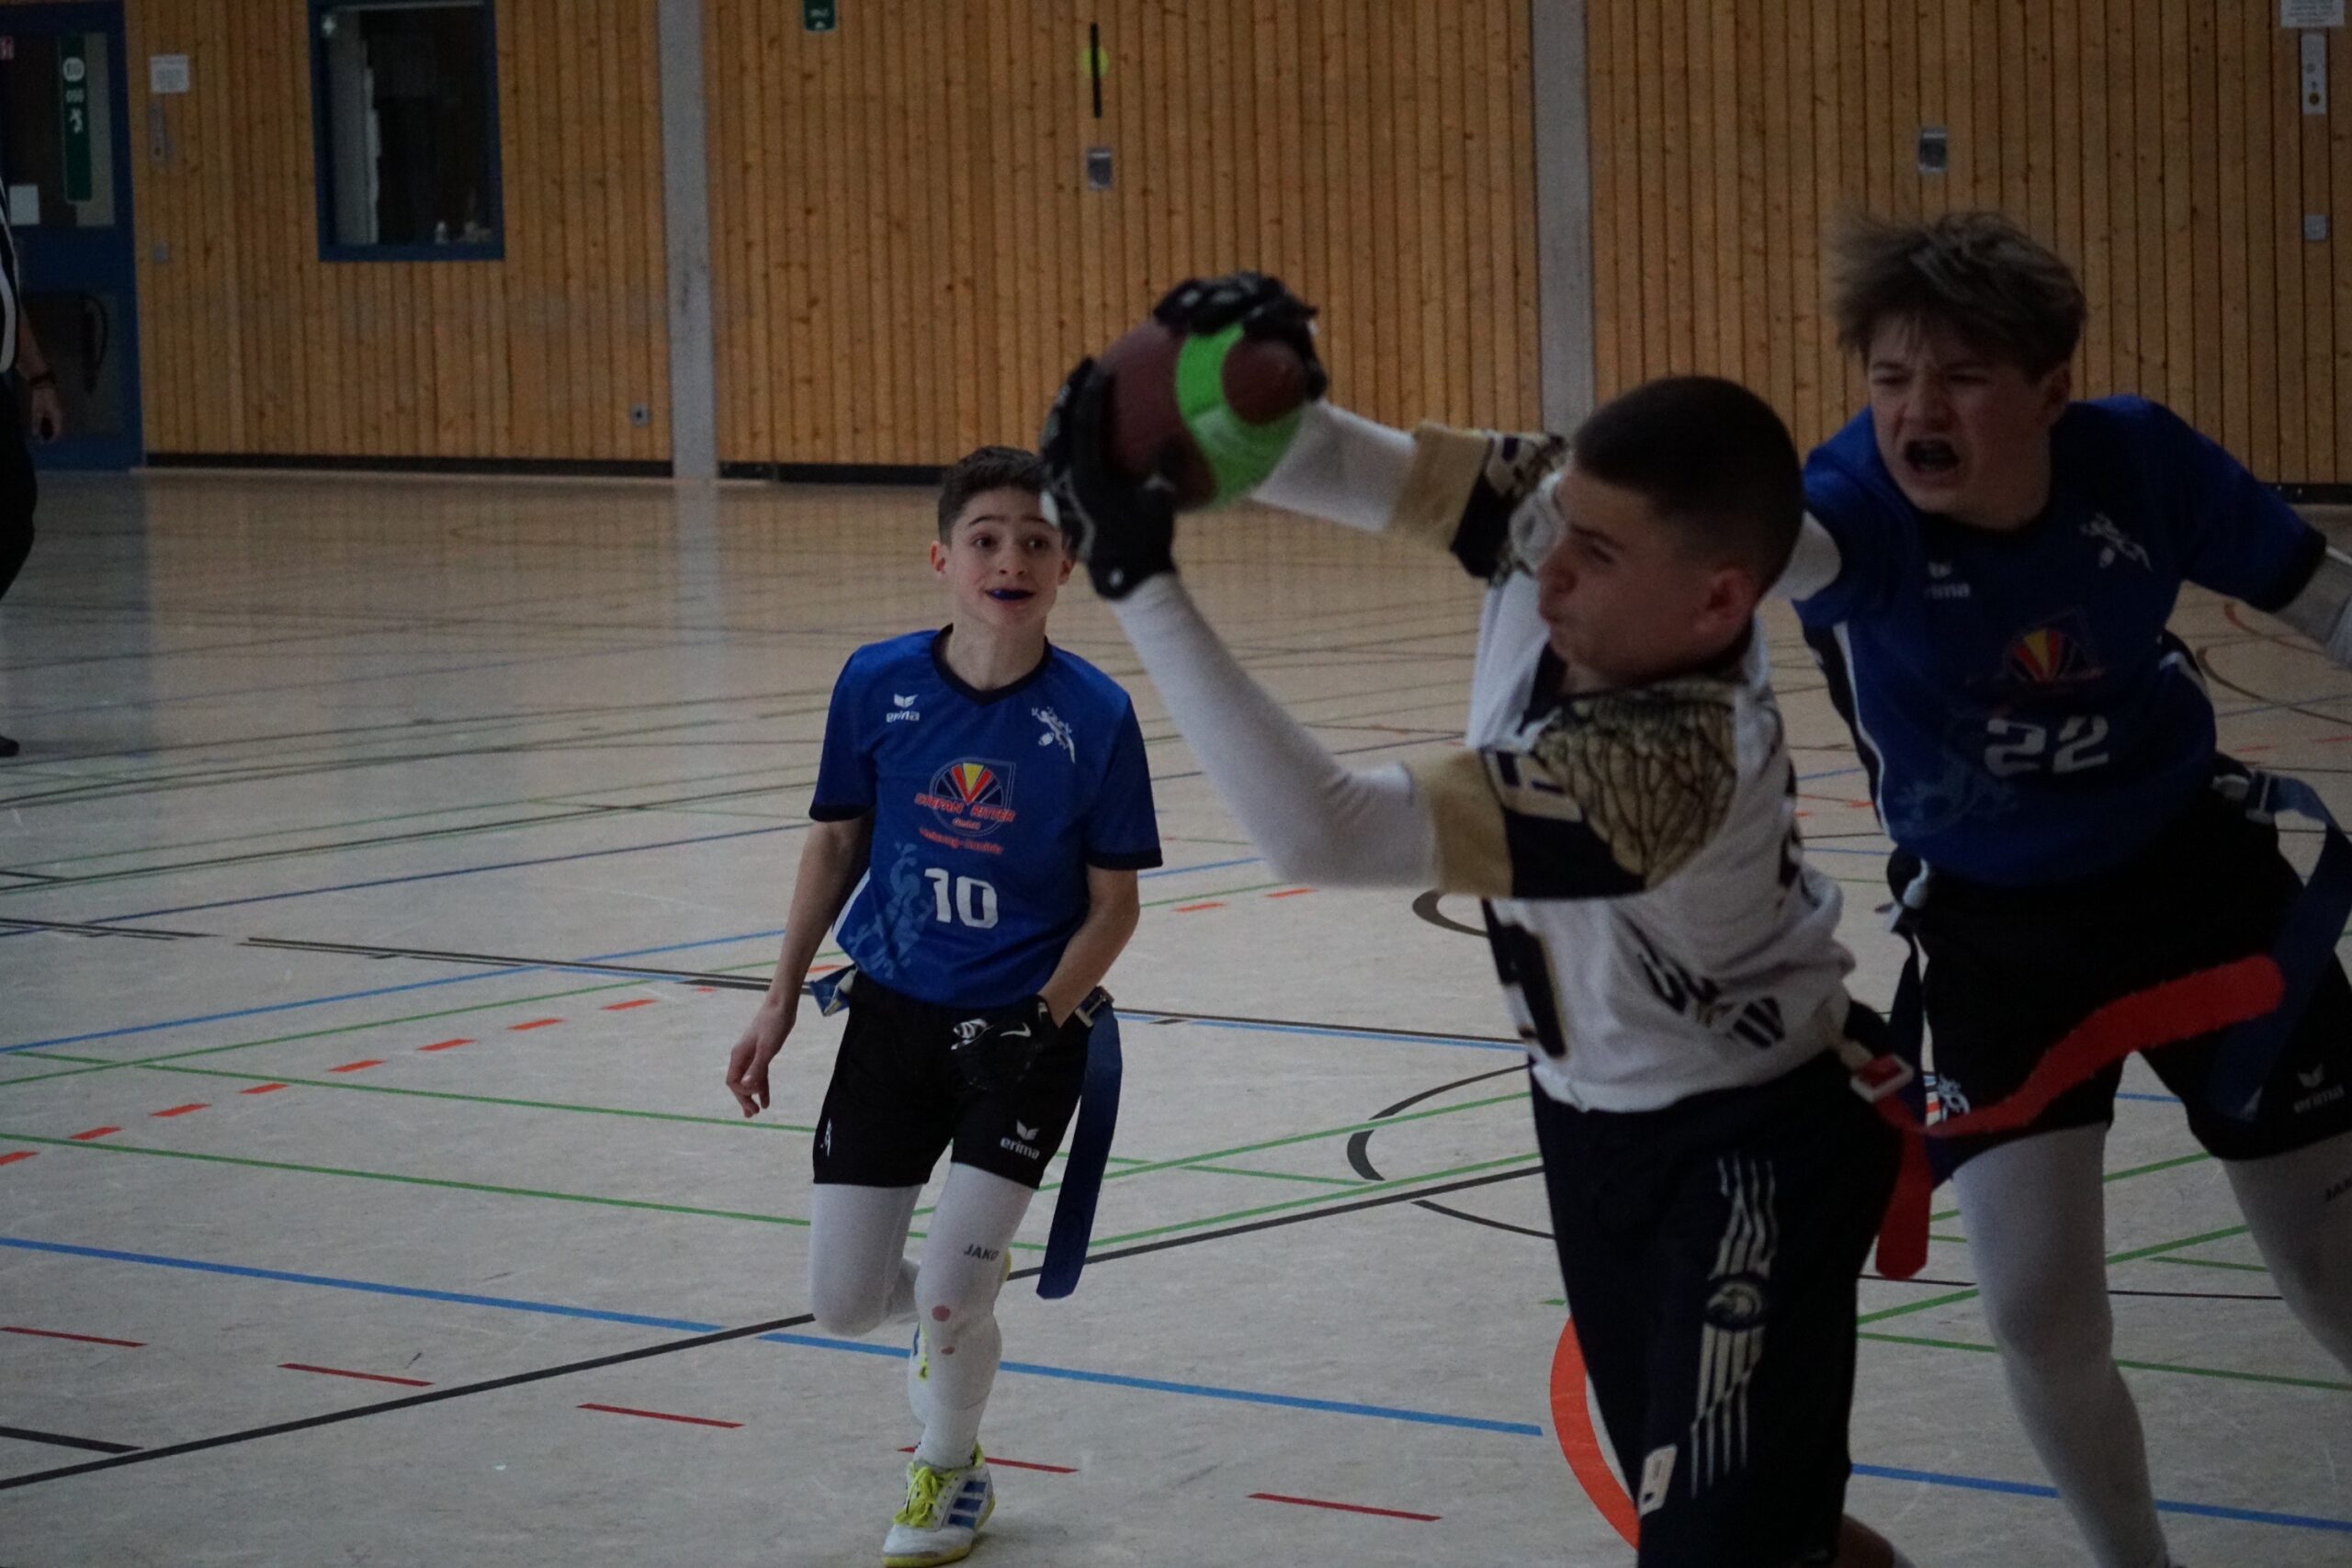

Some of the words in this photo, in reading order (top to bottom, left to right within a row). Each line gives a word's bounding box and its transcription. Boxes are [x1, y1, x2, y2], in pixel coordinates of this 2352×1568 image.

[1984, 714, 2109, 777] 22
[924, 867, 1000, 930] 10
[1000, 1136, 1040, 1160] erima
[964, 1244, 1000, 1261] JAKO
